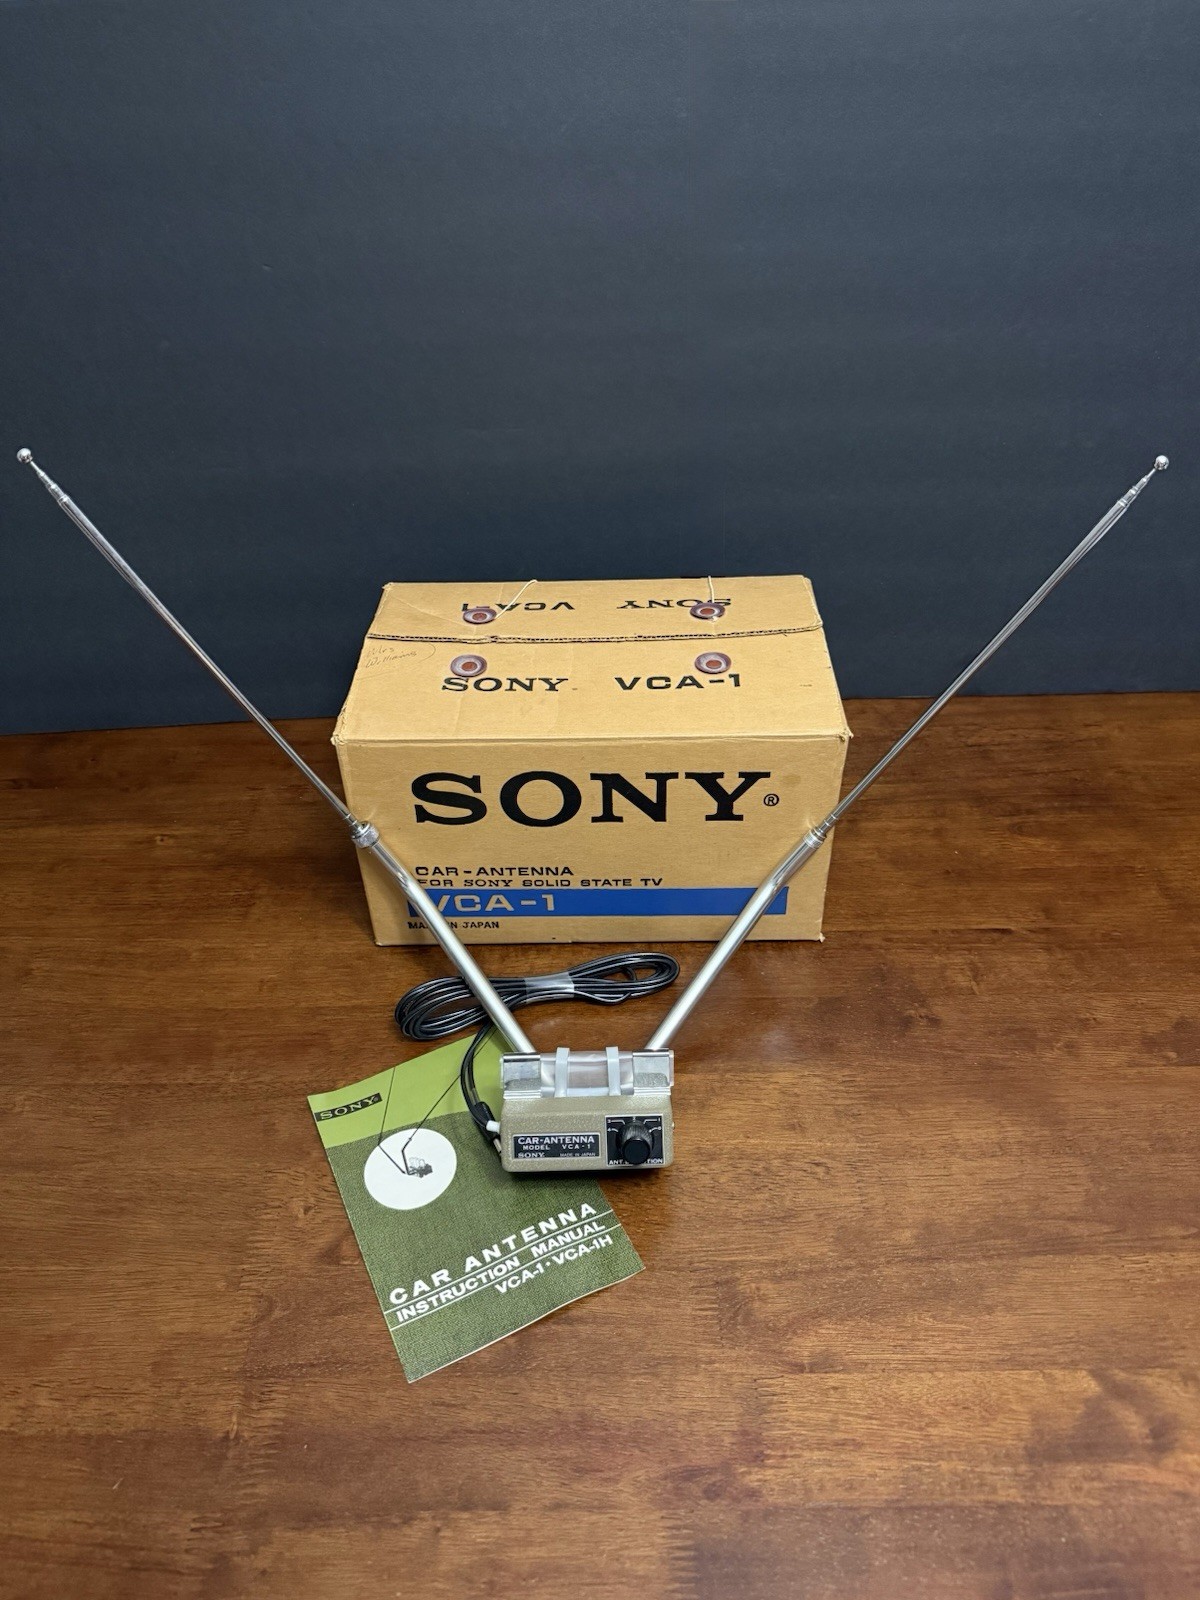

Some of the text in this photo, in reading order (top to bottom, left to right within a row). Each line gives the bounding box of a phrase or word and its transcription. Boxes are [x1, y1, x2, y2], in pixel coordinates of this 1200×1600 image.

[441, 673, 741, 692] SONY VCA-1
[411, 771, 771, 828] SONY
[463, 879, 513, 887] SONY
[522, 879, 571, 887] SOLID
[580, 878, 632, 887] STATE
[640, 878, 663, 887] TV
[462, 921, 500, 929] JAPAN
[320, 1095, 376, 1120] SONY
[517, 1135, 595, 1145] CAR-ANTENNA
[389, 1203, 598, 1305] CAR ANTENNA
[396, 1220, 606, 1322] INSTRUCTION MANUAL
